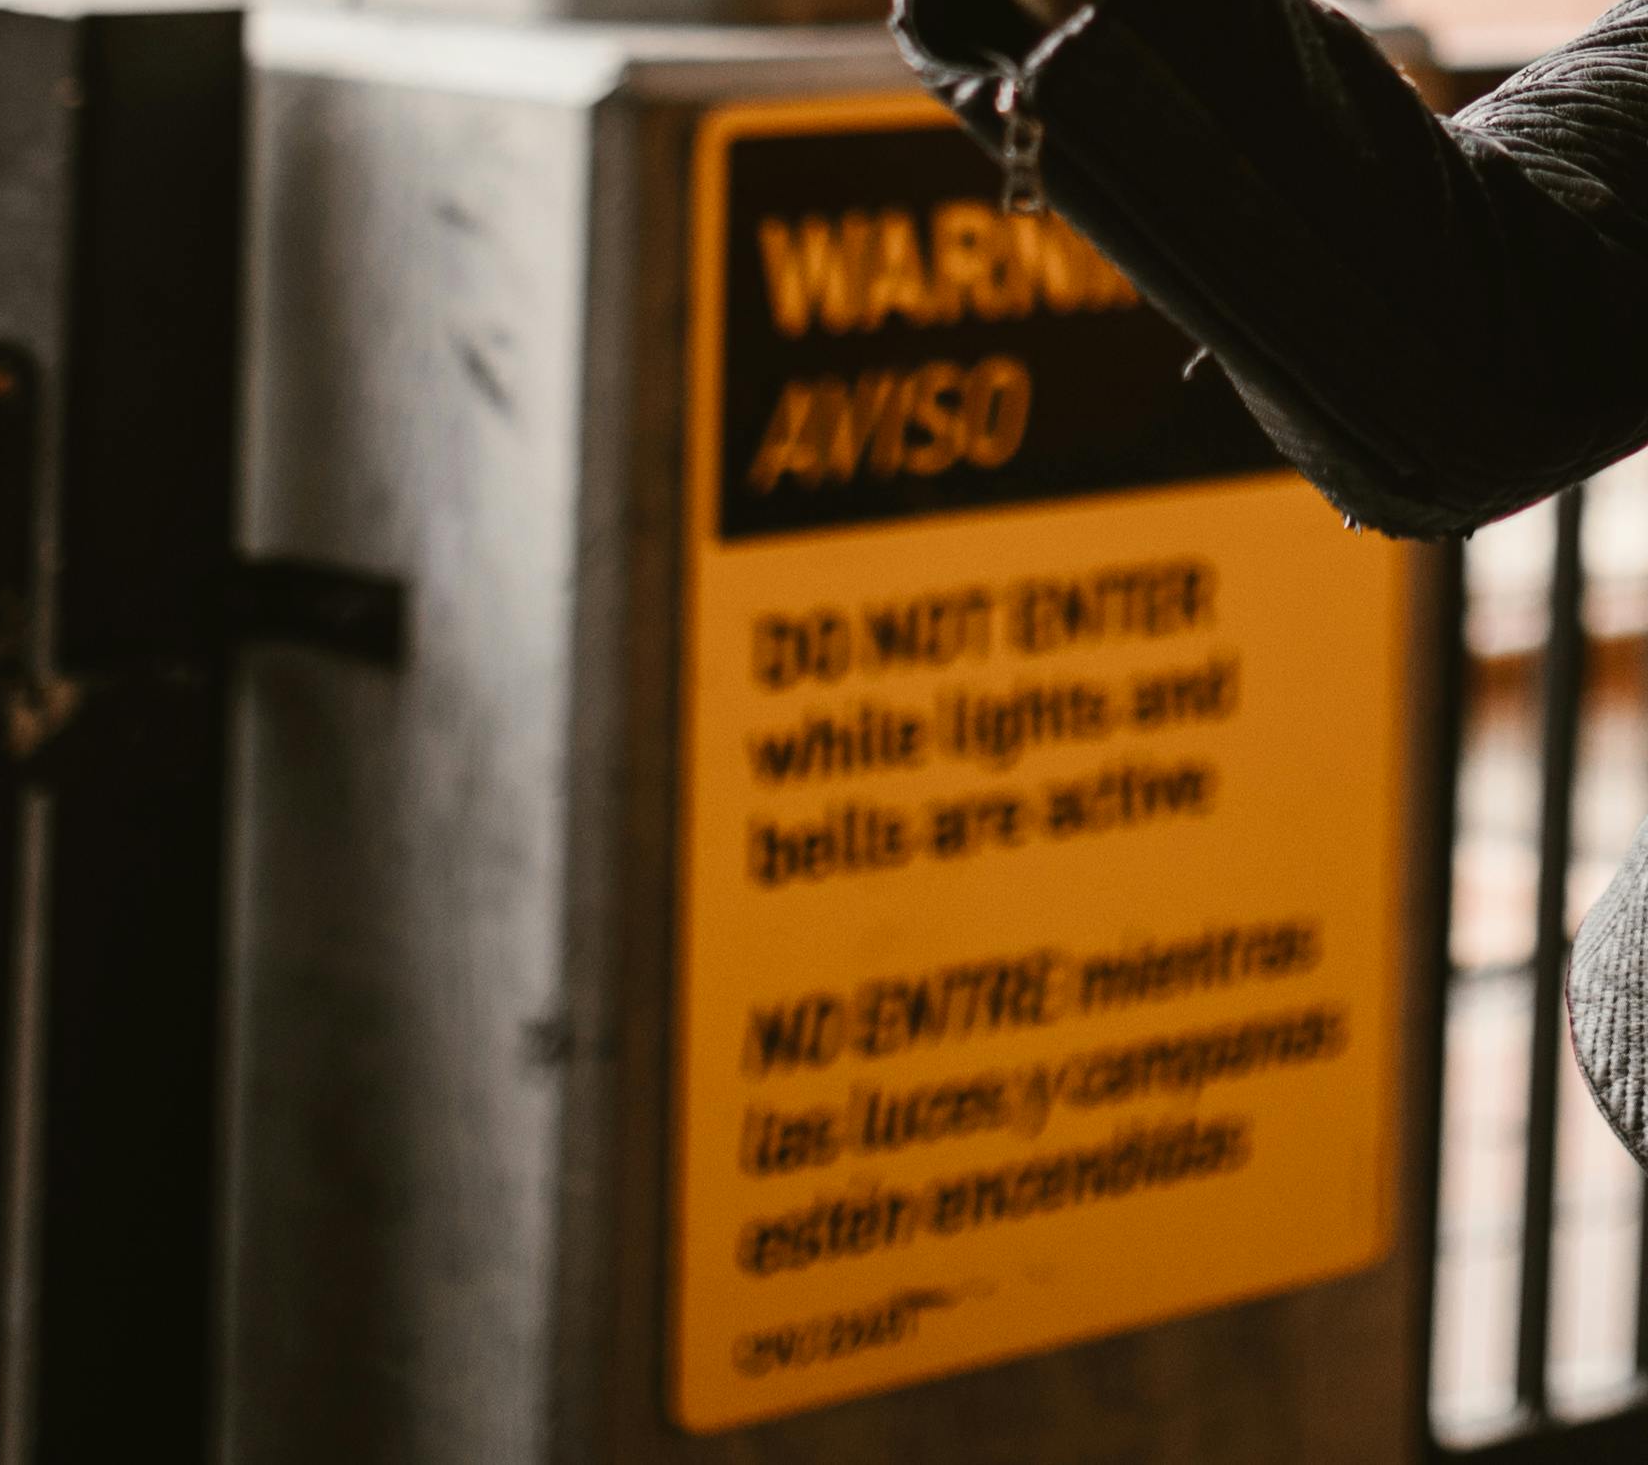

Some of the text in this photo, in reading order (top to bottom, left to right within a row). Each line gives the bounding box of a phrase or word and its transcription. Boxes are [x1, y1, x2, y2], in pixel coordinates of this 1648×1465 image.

[758, 198, 1140, 338] WARN
[747, 354, 1032, 494] AVISO
[754, 555, 1219, 695] DO NOT ENTER
[748, 645, 1241, 790] while lights and
[748, 754, 1221, 892] bells are active
[740, 916, 1323, 1081] NO ENTRE mientras
[849, 1066, 1012, 1157] luces
